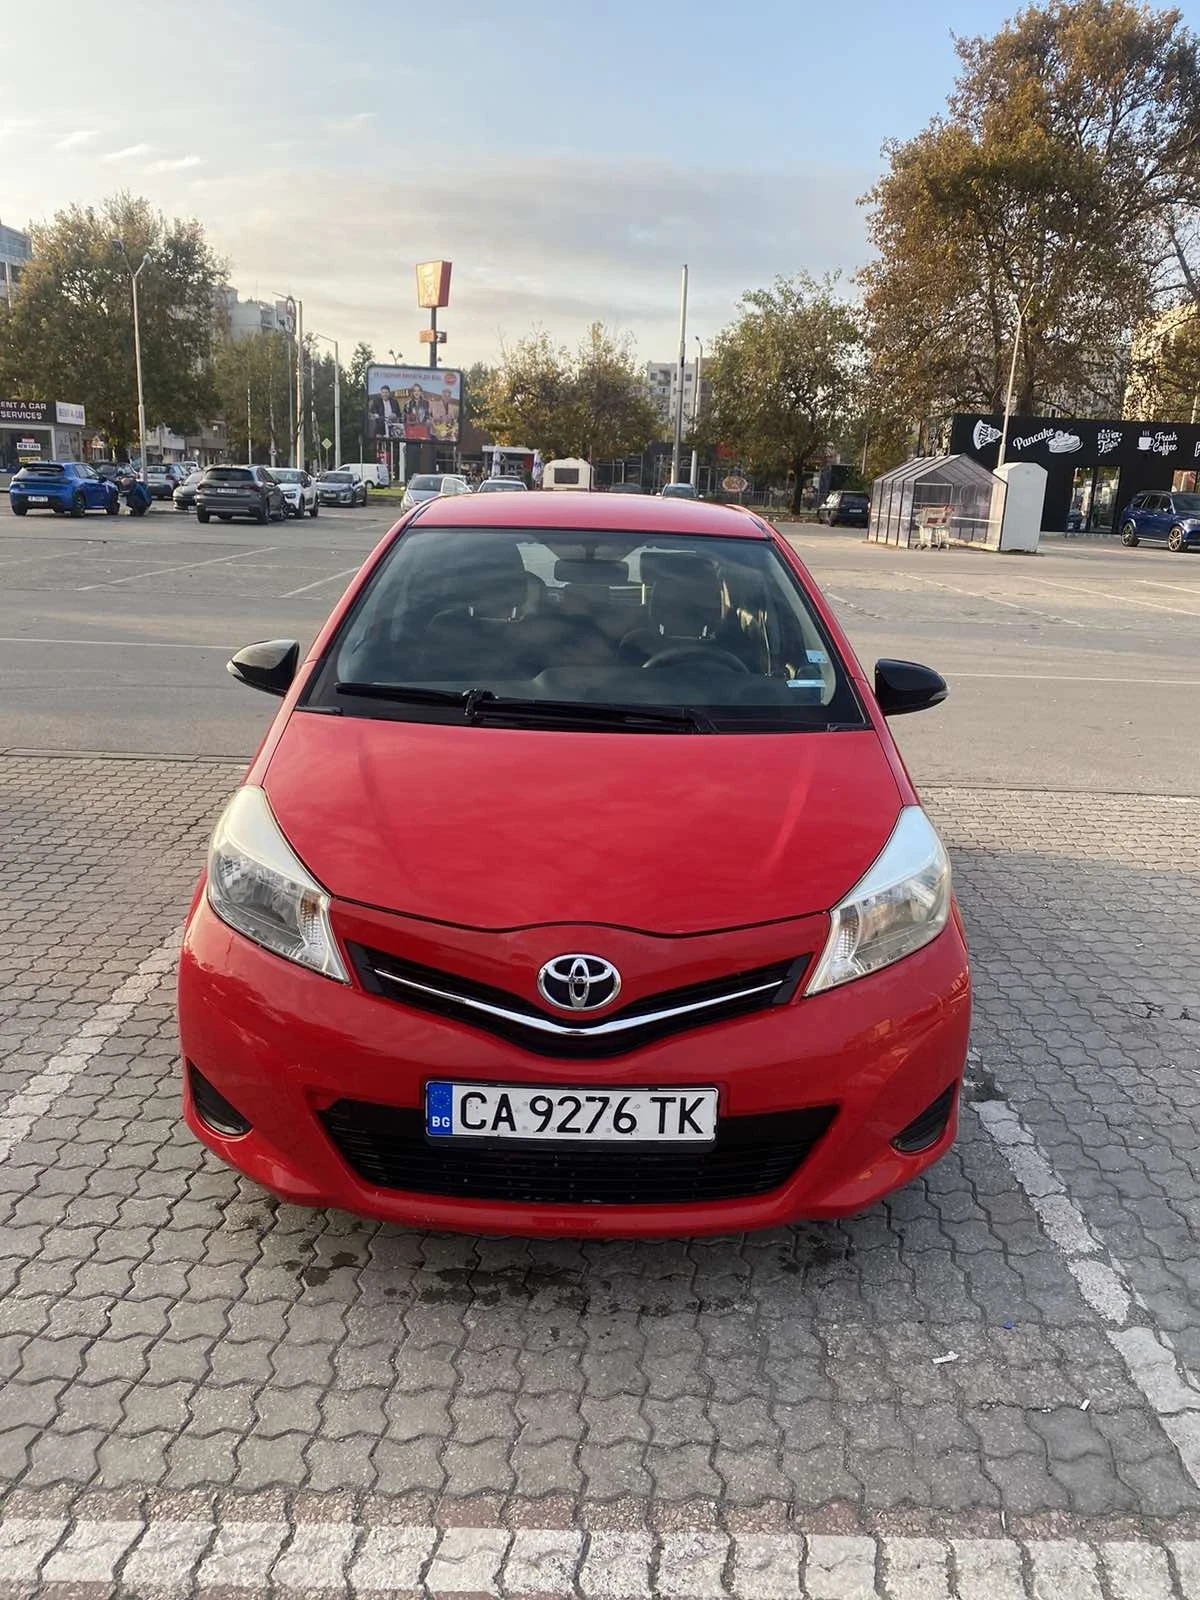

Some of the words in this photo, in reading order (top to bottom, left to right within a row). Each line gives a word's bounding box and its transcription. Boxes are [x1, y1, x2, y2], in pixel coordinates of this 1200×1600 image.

[0, 401, 17, 409] ENT
[0, 410, 42, 420] SERVICES
[1012, 427, 1056, 451] Pancake
[1154, 431, 1179, 442] Fresh
[1152, 441, 1178, 456] Coffee
[460, 1091, 517, 1132] CA
[529, 1095, 637, 1135] 9276
[650, 1096, 705, 1135] TK
[431, 1116, 450, 1128] BG
